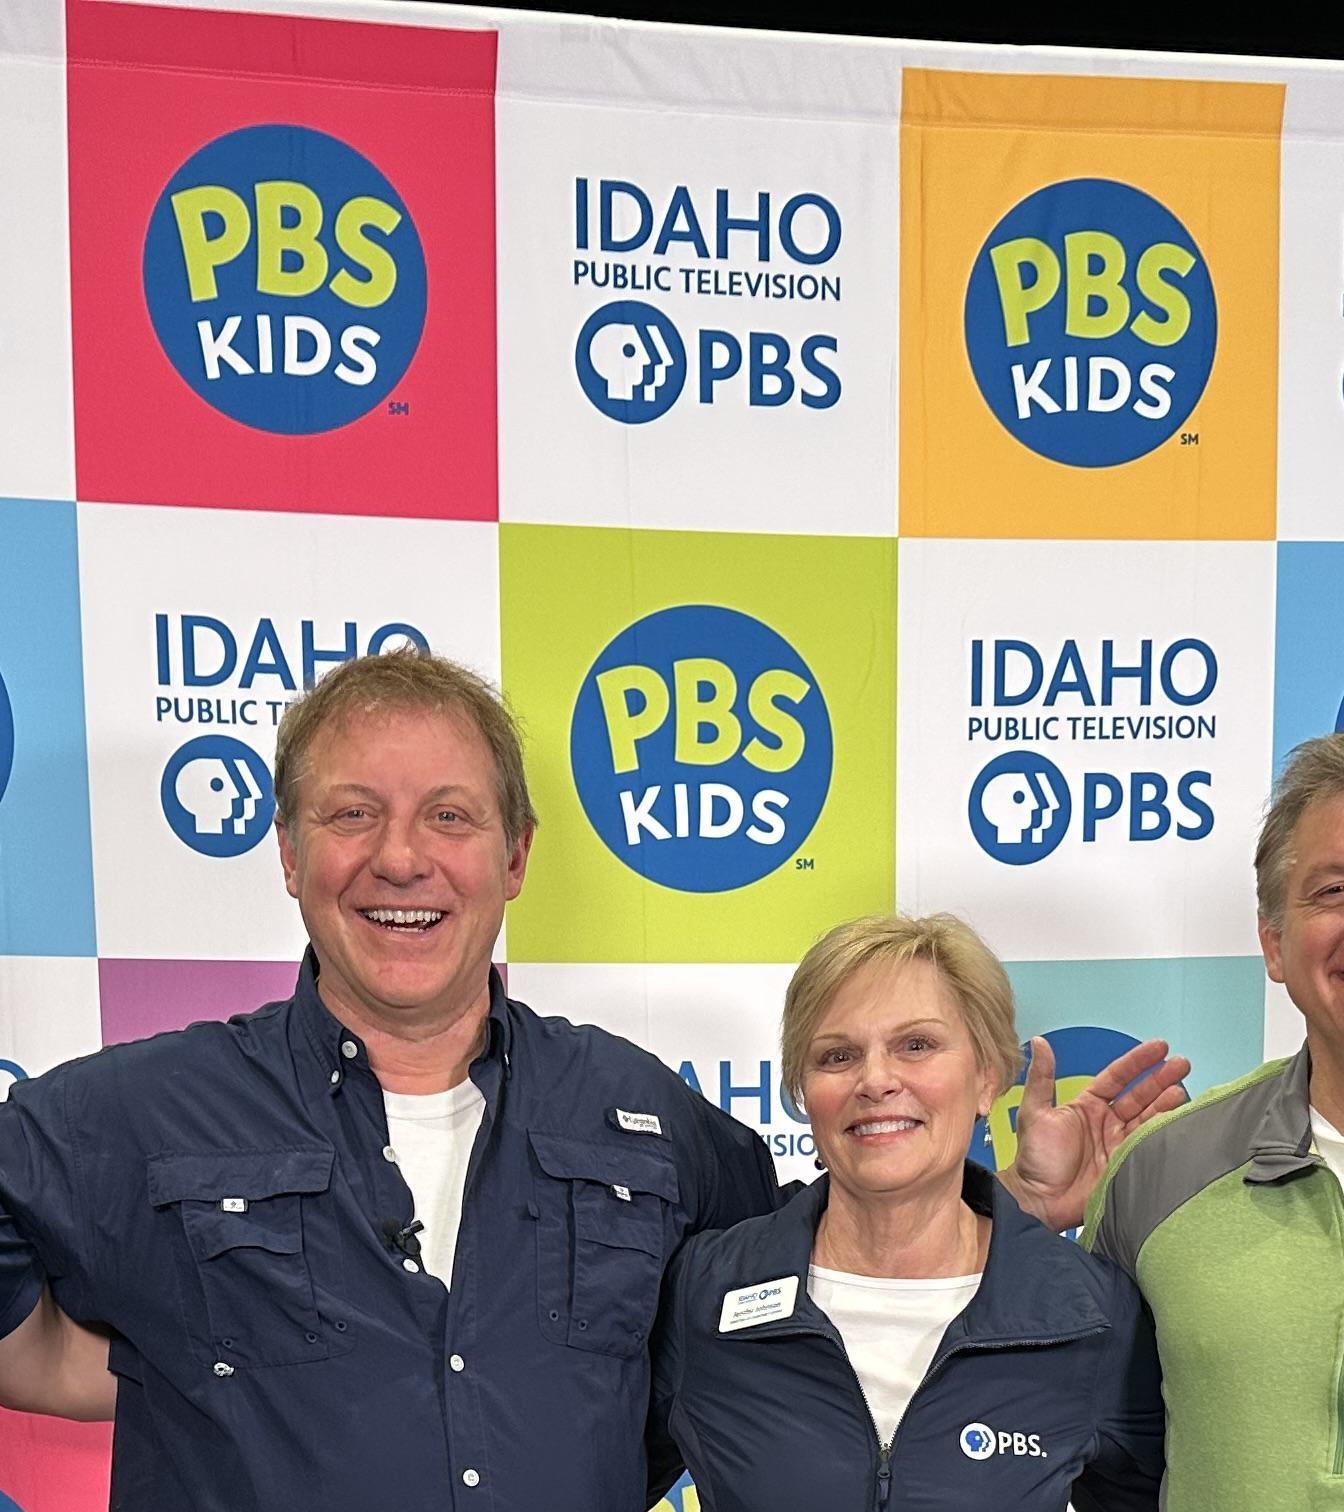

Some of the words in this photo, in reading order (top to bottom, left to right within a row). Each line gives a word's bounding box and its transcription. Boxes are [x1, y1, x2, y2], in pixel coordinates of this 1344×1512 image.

[170, 180, 403, 308] PBS
[575, 176, 842, 266] IDAHO
[574, 261, 671, 293] PUBLIC
[679, 270, 841, 302] TELEVISION
[988, 229, 1197, 347] PBS
[197, 314, 382, 387] KIDS
[698, 329, 842, 411] PBS
[1012, 357, 1175, 421] KIDS
[1180, 434, 1199, 446] SM
[970, 638, 1218, 708] IDAHO
[156, 696, 258, 725] PUBLIC
[596, 657, 811, 774] PBS
[968, 716, 1059, 742] PUBLIC
[1066, 715, 1217, 741] TELEVISION
[619, 782, 790, 846] KIDS
[1082, 770, 1214, 843] PBS
[795, 859, 815, 870] SM
